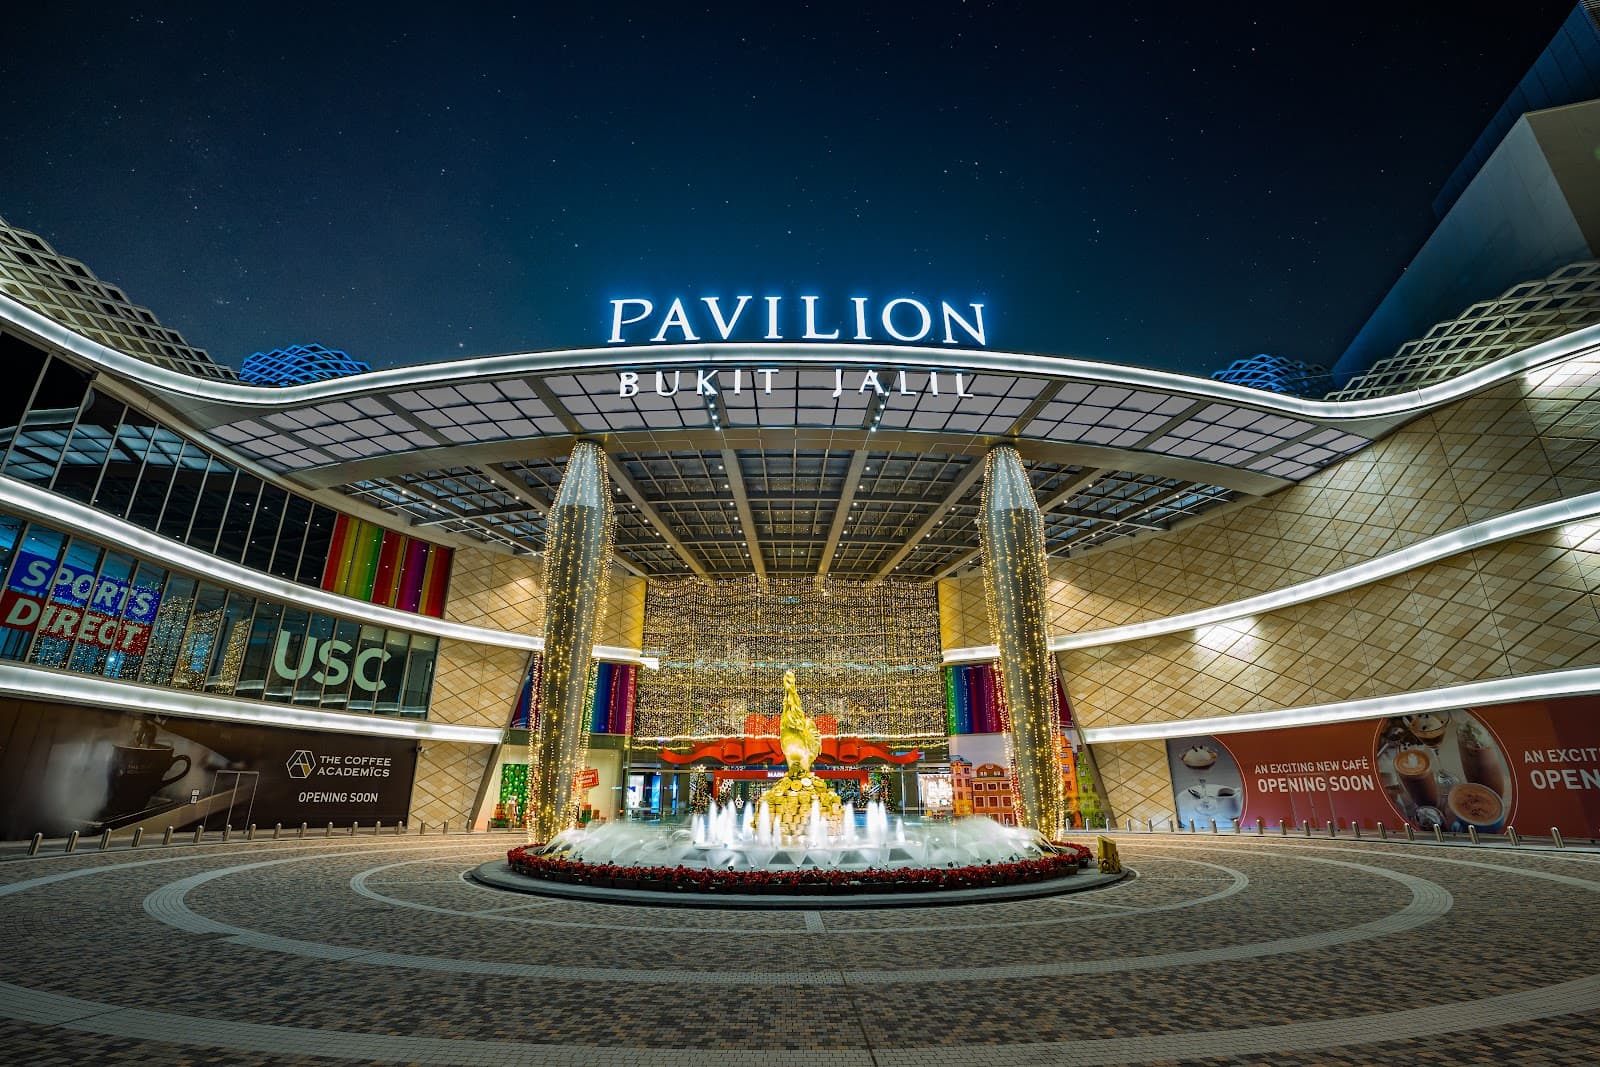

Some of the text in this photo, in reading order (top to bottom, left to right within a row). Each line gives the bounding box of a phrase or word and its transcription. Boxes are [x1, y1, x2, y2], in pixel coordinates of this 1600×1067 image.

[607, 295, 986, 346] PAVILION
[619, 368, 974, 398] BUKIT JALIL
[21, 560, 153, 616] SPORTS
[5, 598, 143, 649] DIRECT
[274, 628, 391, 692] USC
[319, 755, 392, 766] THE COFFEE
[1254, 756, 1370, 775] AN EXCITING NEW CAFÉ
[1524, 747, 1600, 764] AN EXCIT
[1257, 774, 1375, 793] OPENING SOON
[298, 791, 379, 803] OPENING SOON
